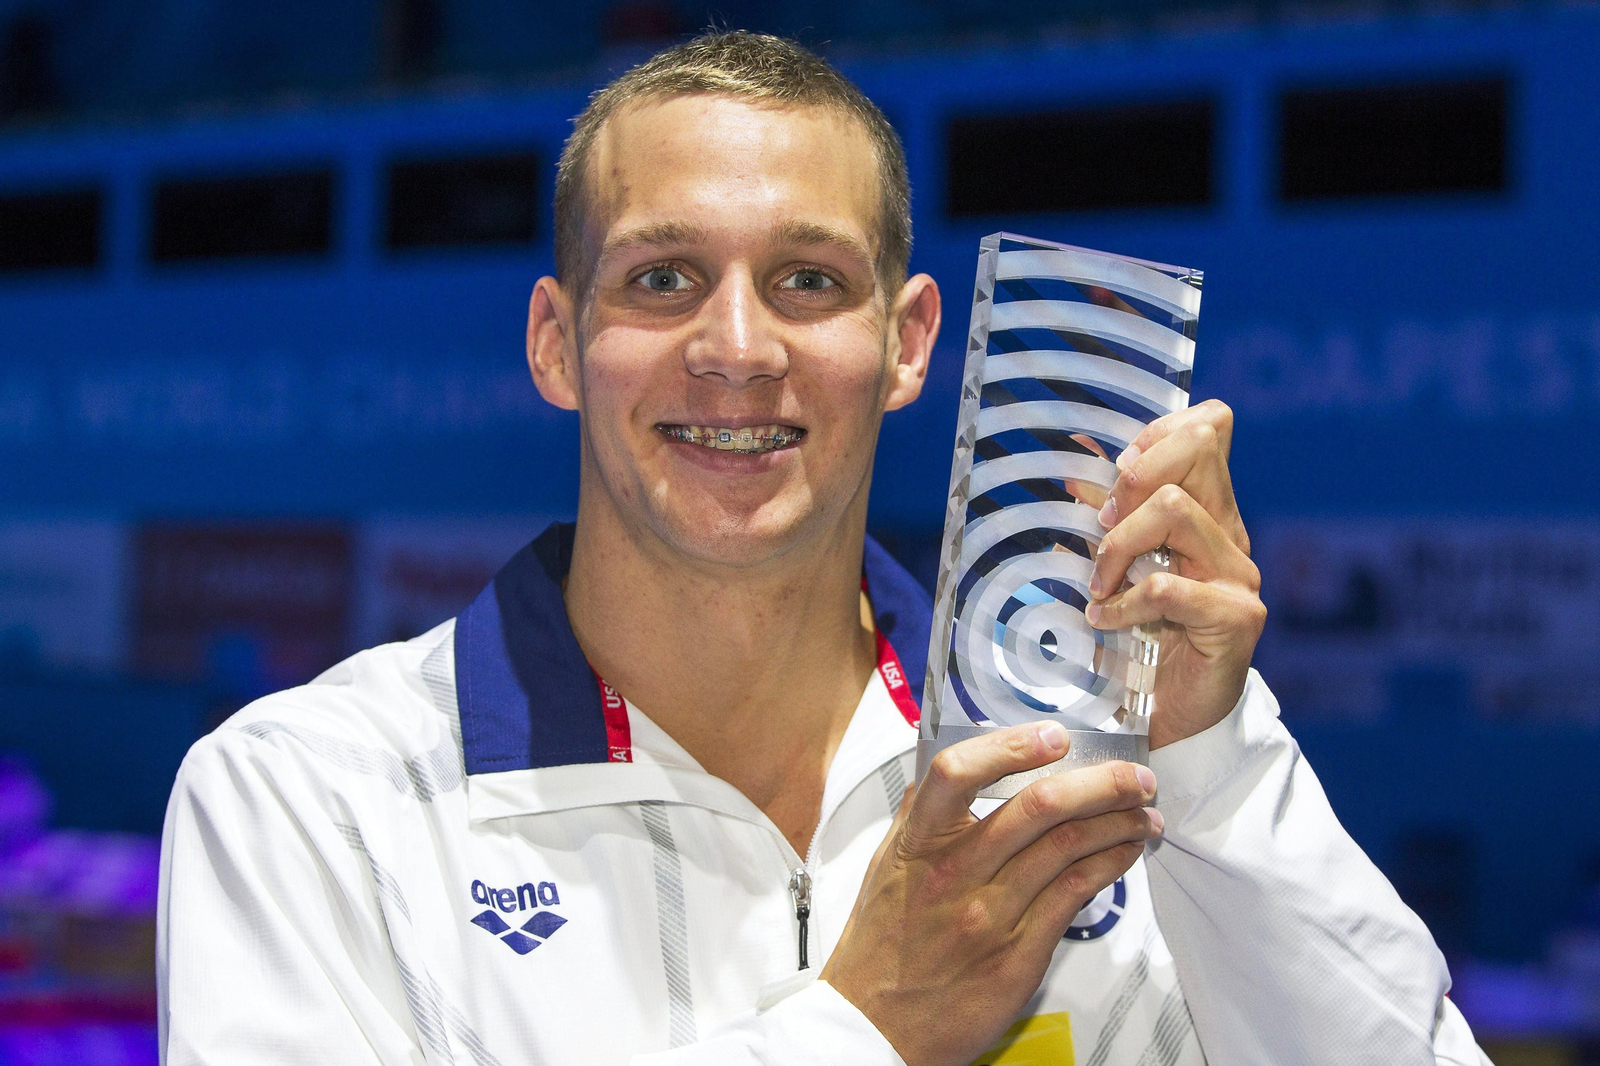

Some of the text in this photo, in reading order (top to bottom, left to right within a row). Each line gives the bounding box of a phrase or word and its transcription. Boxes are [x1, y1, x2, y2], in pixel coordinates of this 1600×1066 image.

[881, 661, 904, 691] USA
[602, 679, 621, 708] US
[470, 879, 560, 913] arena
